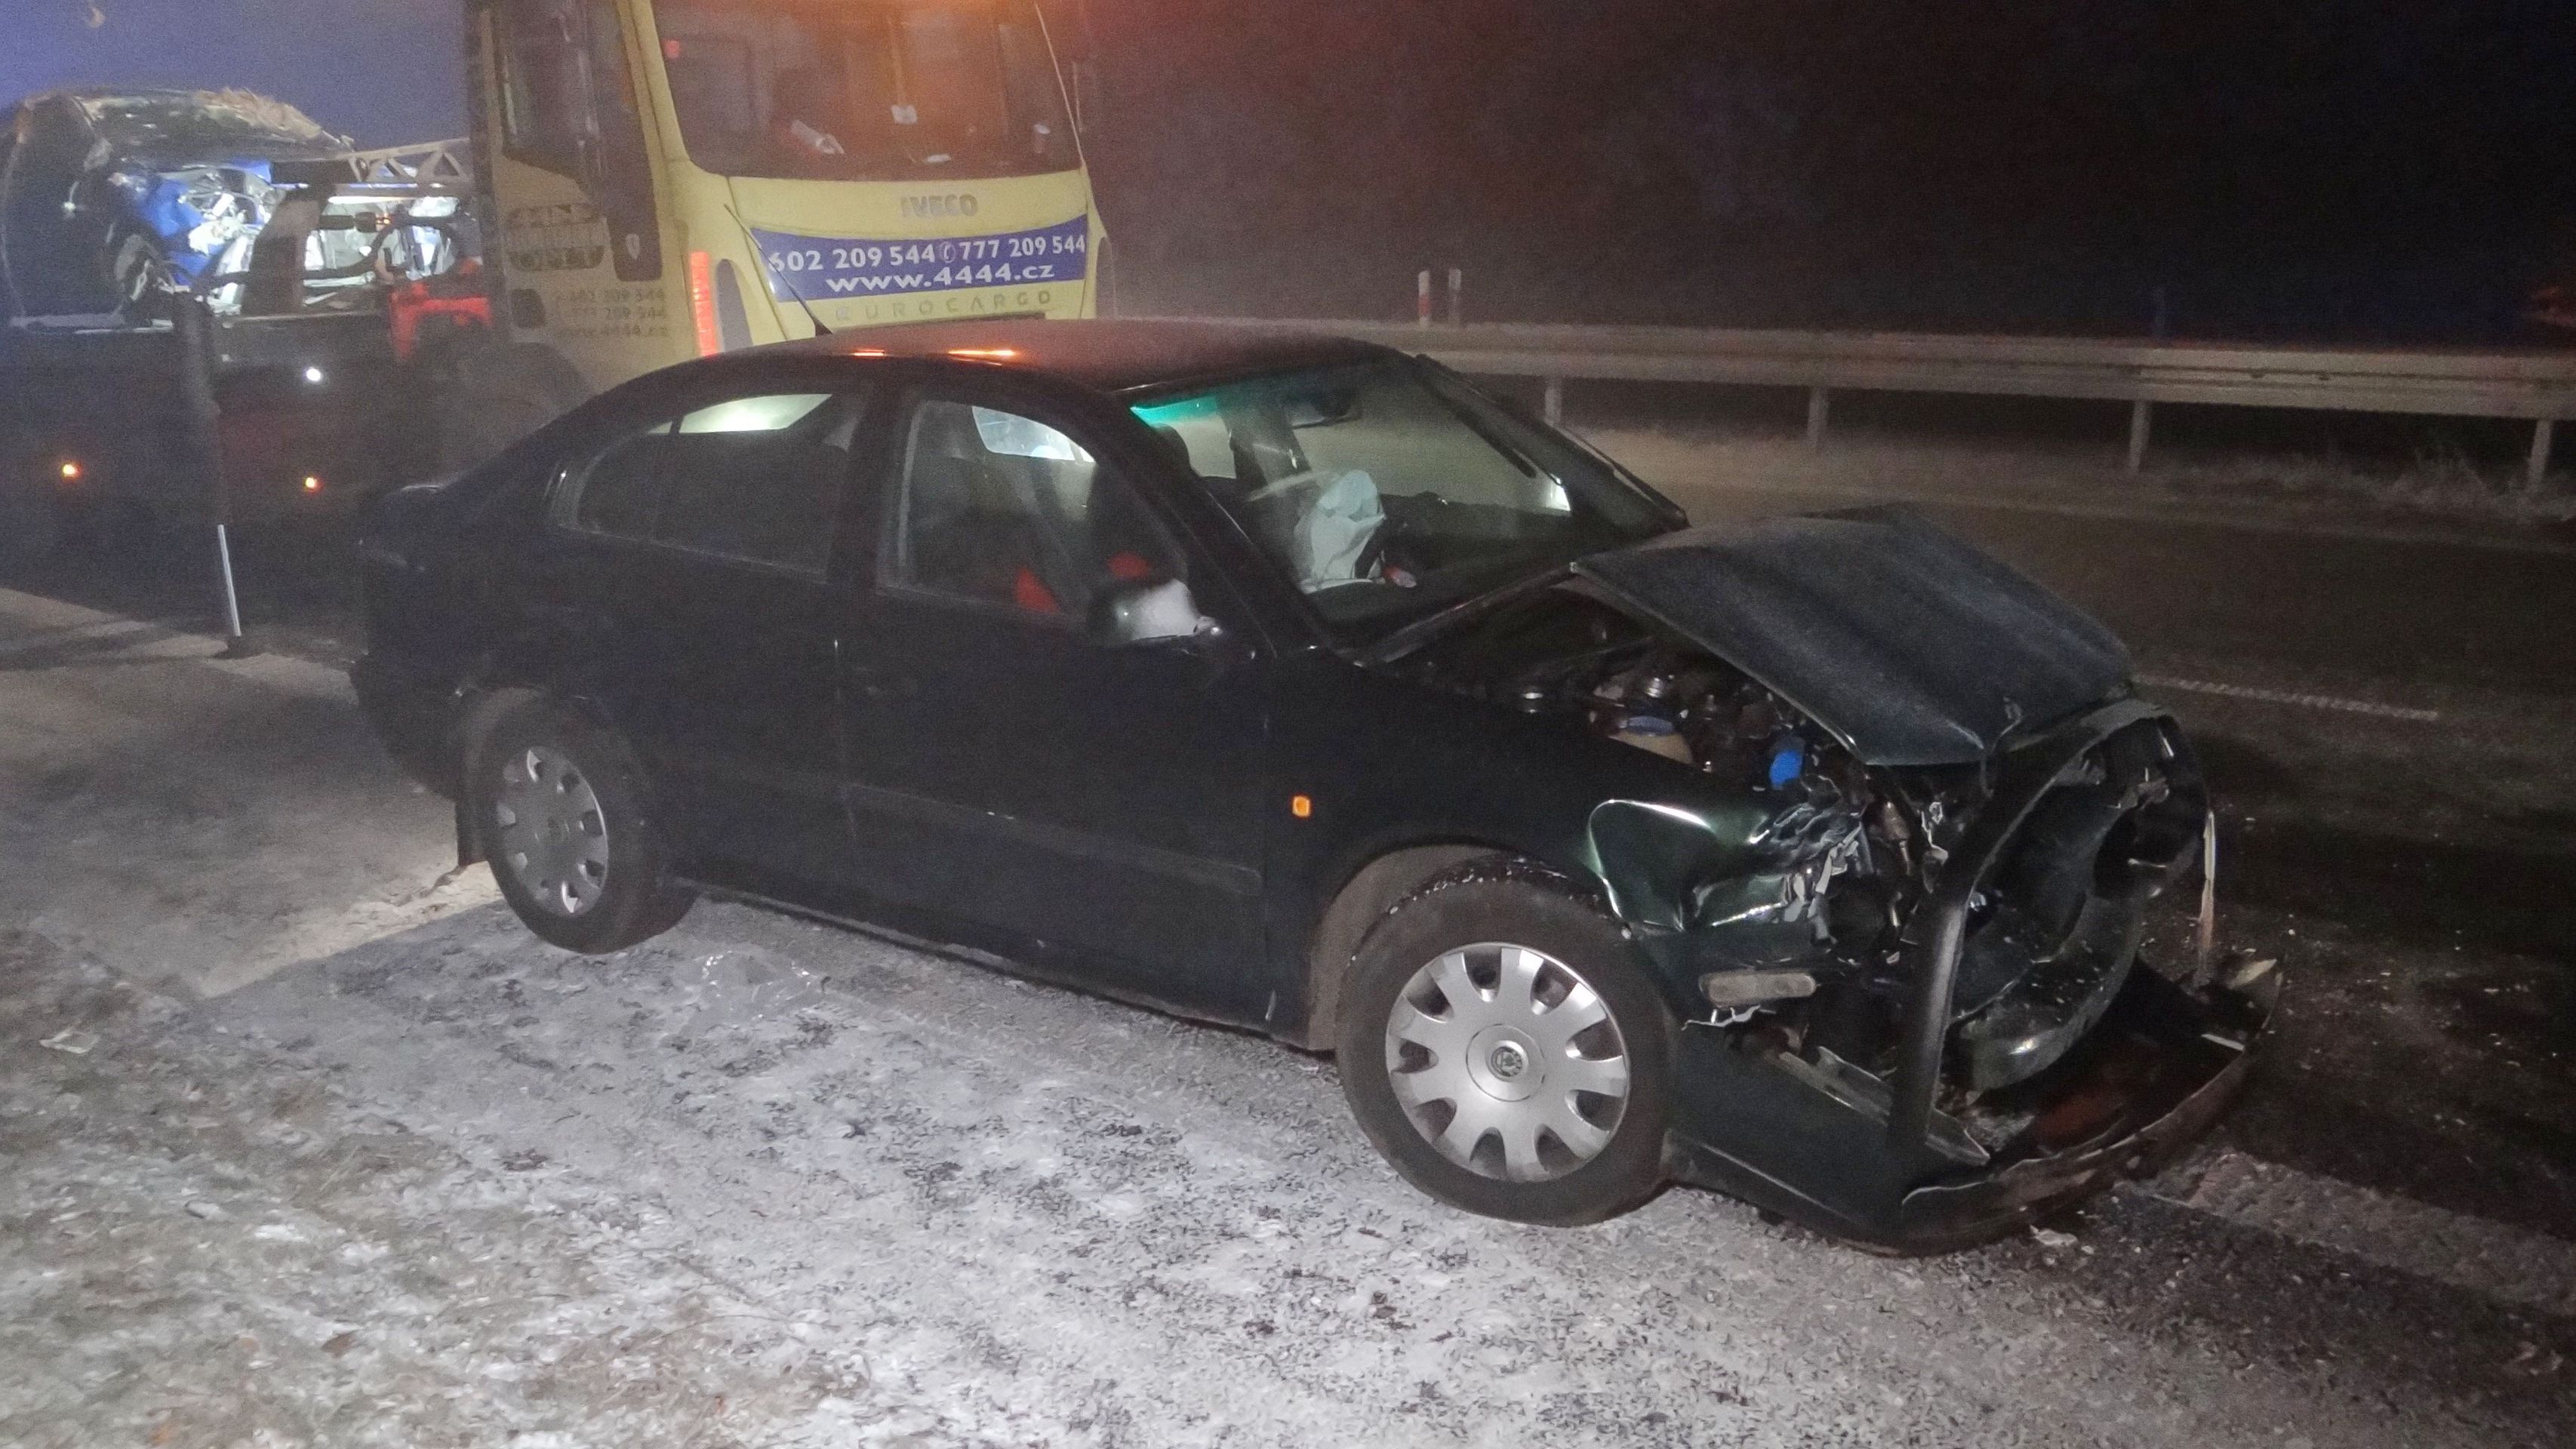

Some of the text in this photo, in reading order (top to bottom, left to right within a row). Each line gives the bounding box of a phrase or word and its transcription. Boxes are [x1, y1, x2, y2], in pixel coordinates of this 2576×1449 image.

[900, 193, 977, 217] IVECO
[768, 235, 1085, 272] 602 209 544 777 209 544
[825, 263, 1055, 293] www.4444.cz
[836, 291, 1051, 320] EUROCARGO
